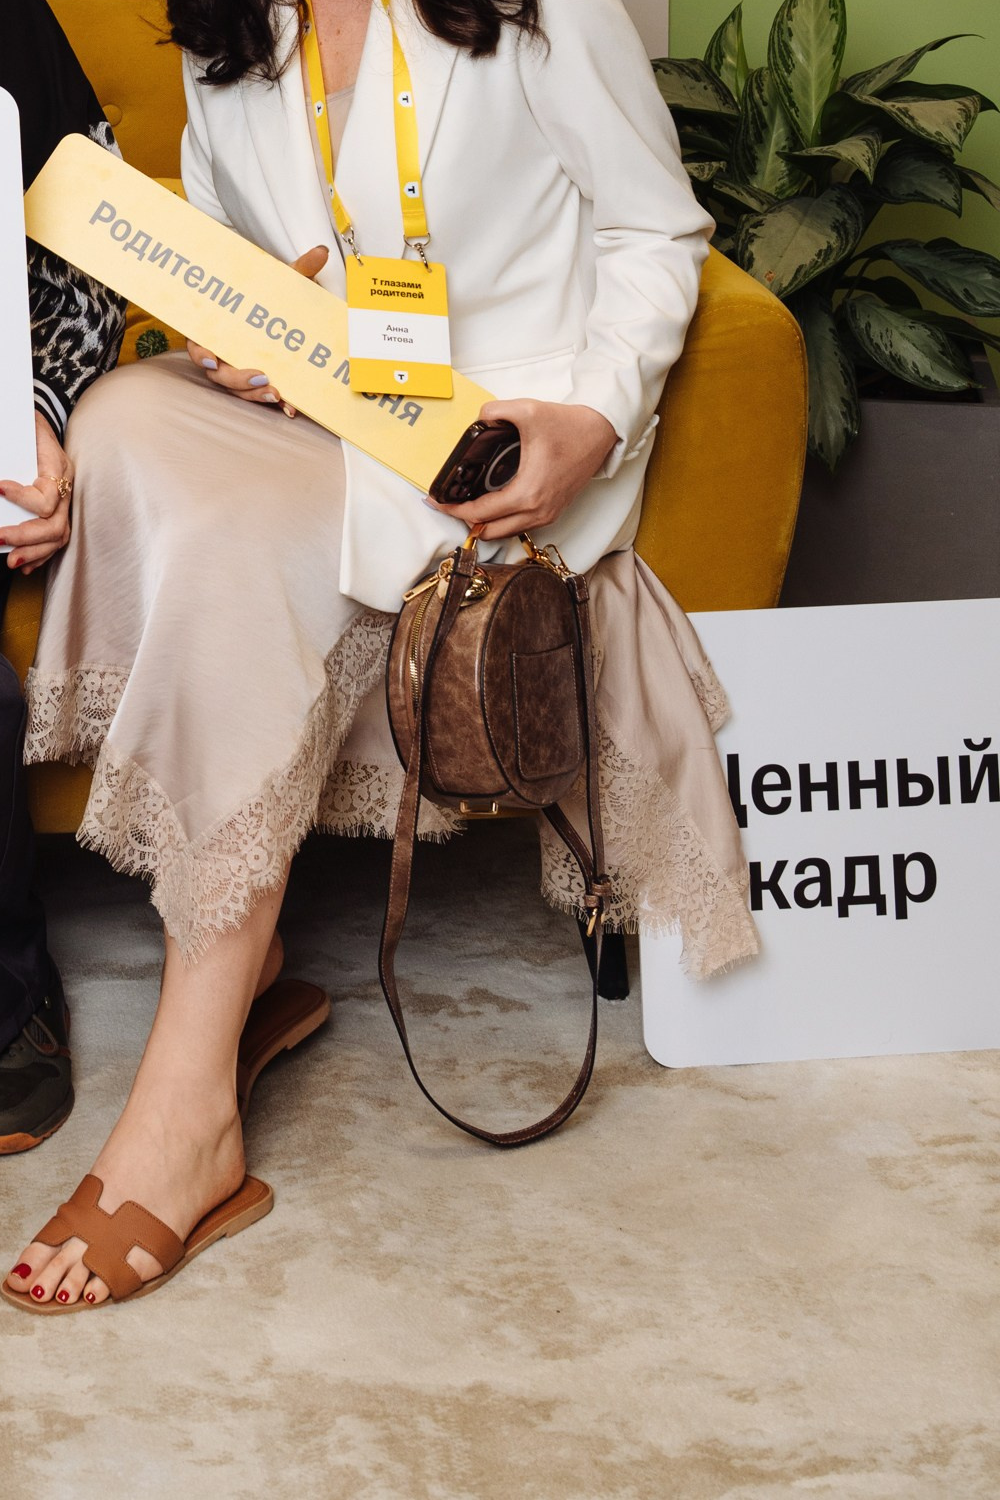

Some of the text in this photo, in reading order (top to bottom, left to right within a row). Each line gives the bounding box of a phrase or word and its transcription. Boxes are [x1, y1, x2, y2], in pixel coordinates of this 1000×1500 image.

[372, 278, 422, 289] Т глазами
[370, 288, 424, 299] родителей
[89, 200, 424, 427] Родители все в мня
[386, 324, 409, 334] Анна
[382, 334, 414, 344] Титова
[748, 851, 938, 920] кадр
